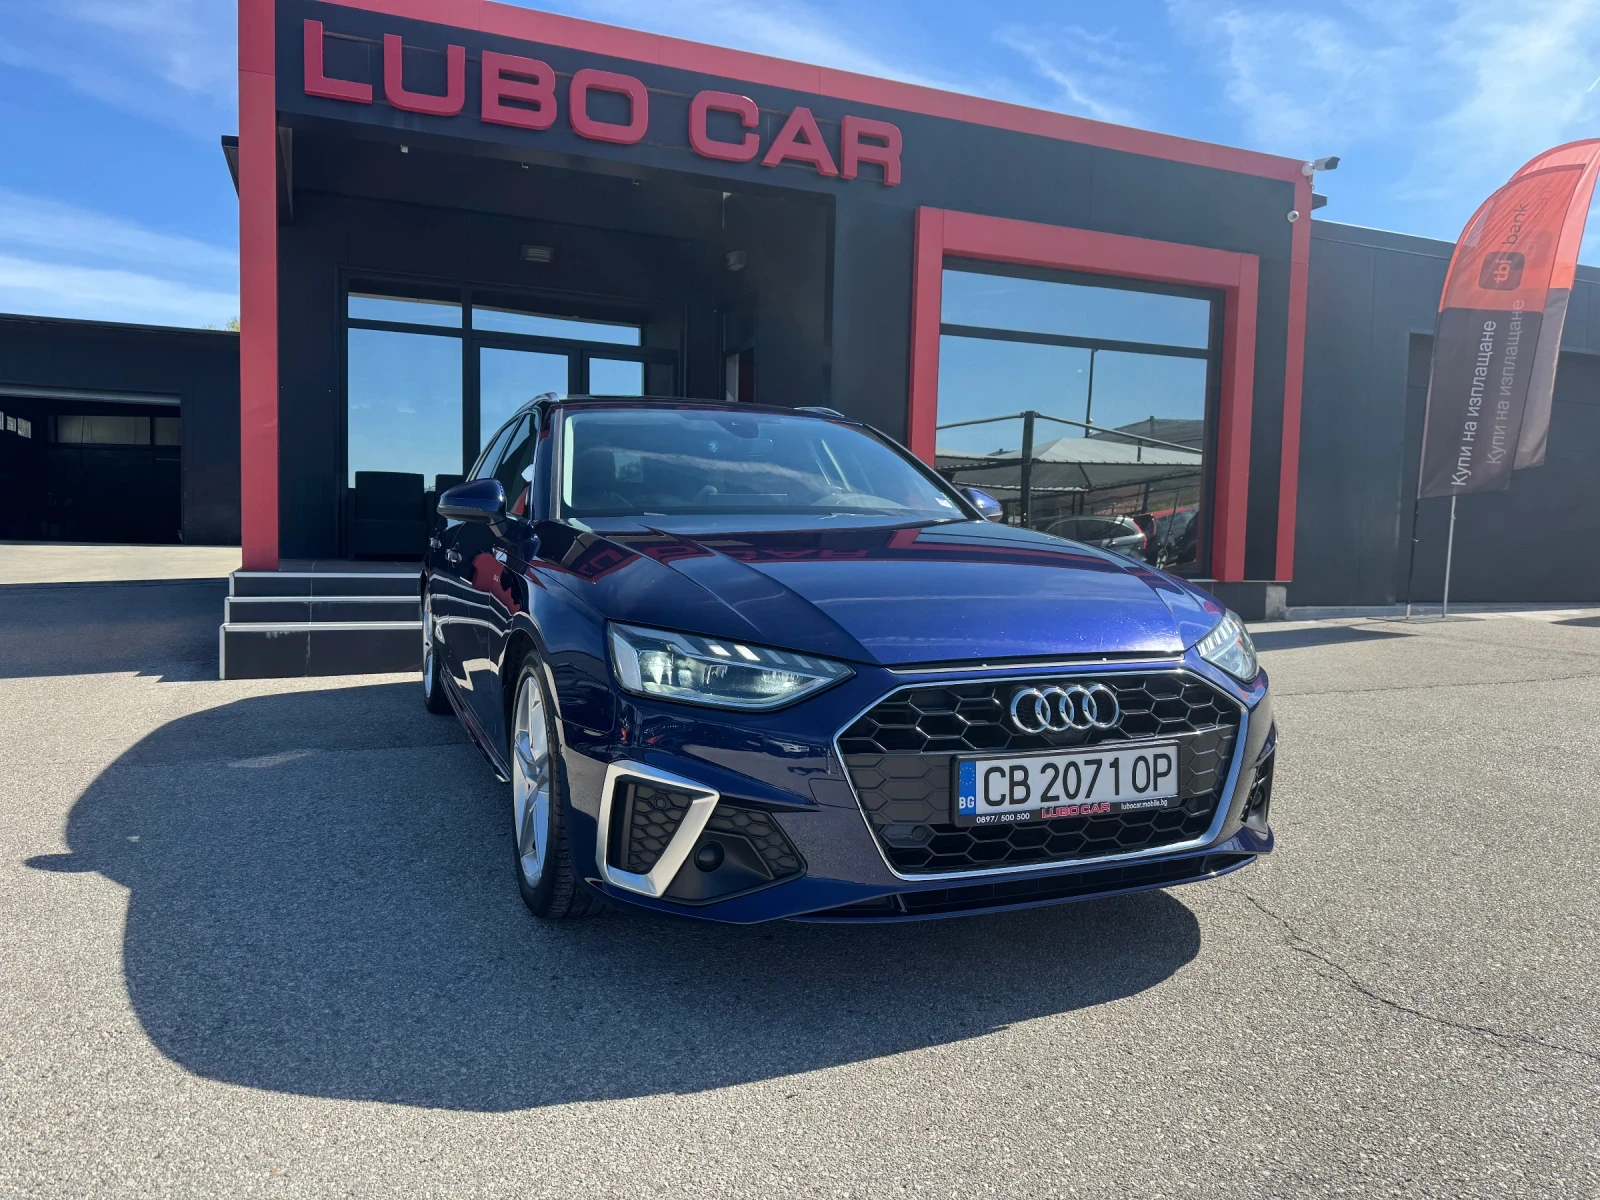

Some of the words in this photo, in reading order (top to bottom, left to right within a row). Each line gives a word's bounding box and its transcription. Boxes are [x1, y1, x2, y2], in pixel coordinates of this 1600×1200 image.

[303, 18, 649, 145] LUBO
[688, 90, 903, 186] CAR
[1501, 203, 1529, 245] bank
[1493, 259, 1512, 284] tbi
[1499, 299, 1525, 396] изплащане
[1467, 320, 1497, 417] изплащане
[1496, 400, 1510, 420] на
[1462, 420, 1478, 442] на
[1486, 425, 1507, 464] Купи
[1451, 445, 1473, 486] Купи
[983, 764, 1031, 807] CB
[1040, 757, 1120, 803] 2071
[1131, 753, 1172, 794] OP
[958, 796, 975, 809] BG
[976, 815, 999, 824] 0897/
[1001, 813, 1015, 822] 500
[1016, 812, 1030, 820] 500
[1041, 805, 1079, 819] LUBO
[1081, 802, 1111, 815] CAR
[1121, 799, 1168, 810] lubocar.mobile.bg
